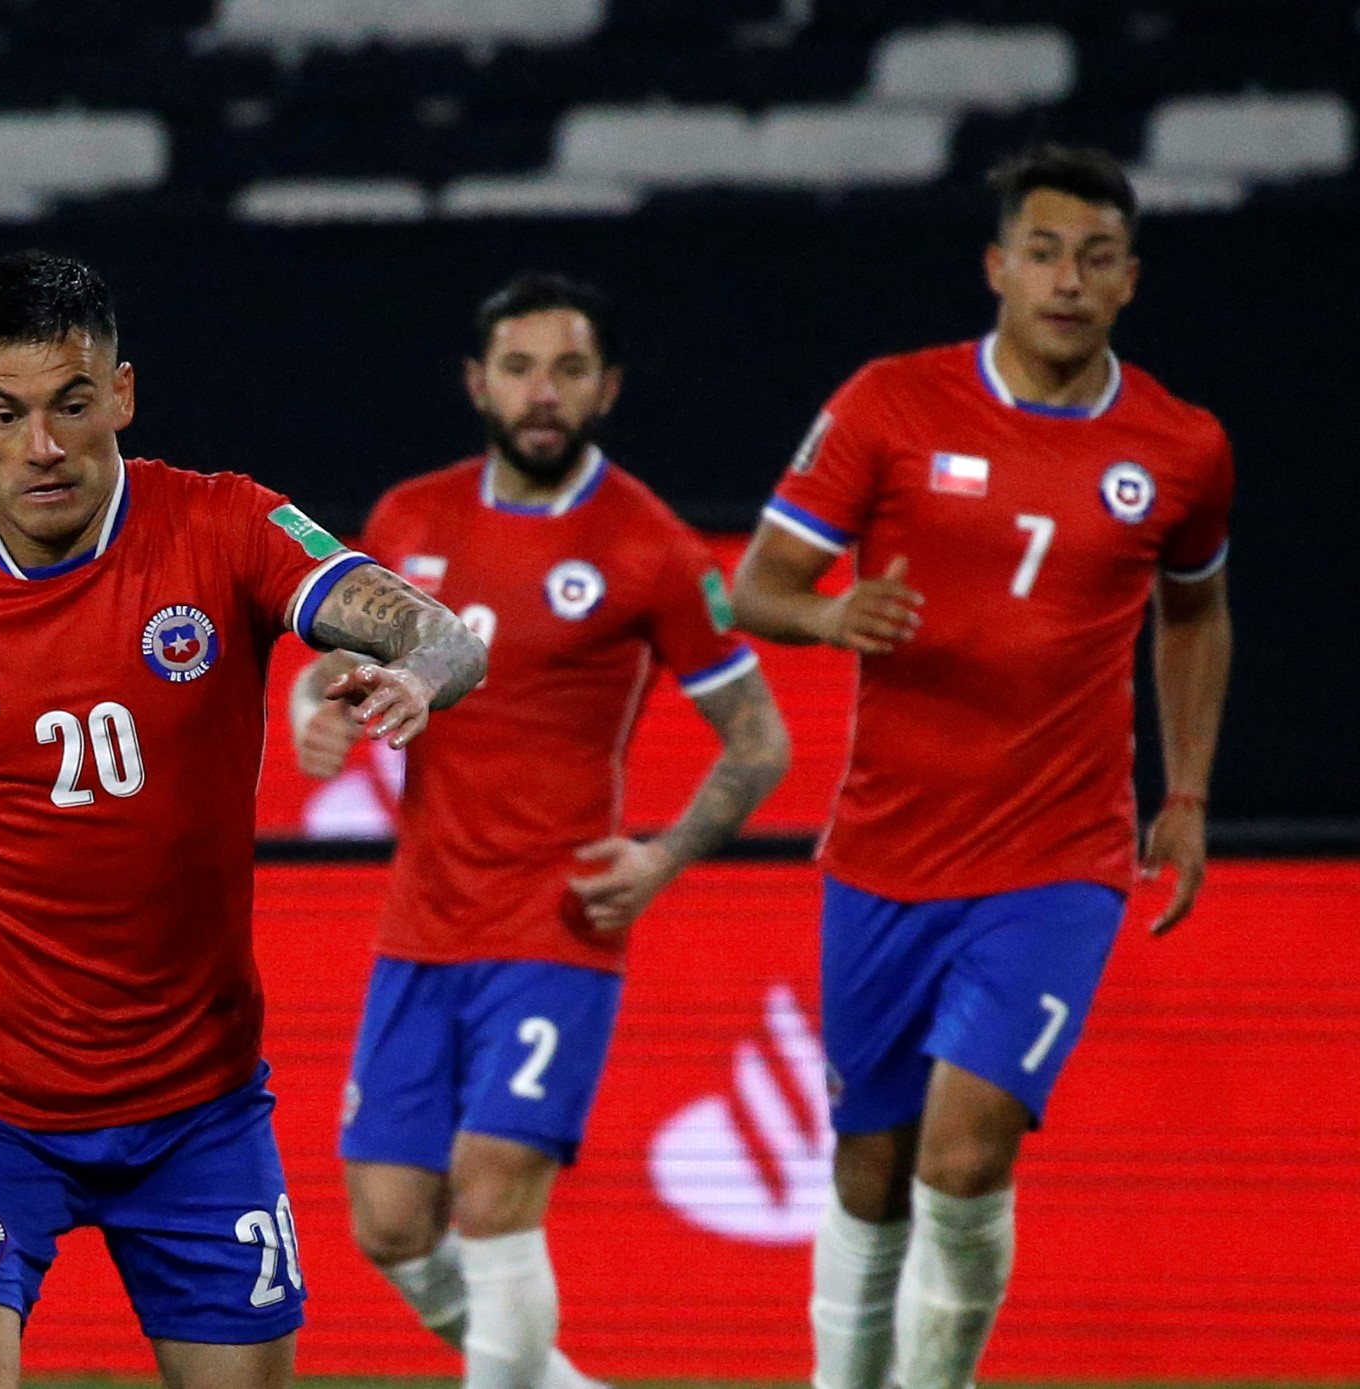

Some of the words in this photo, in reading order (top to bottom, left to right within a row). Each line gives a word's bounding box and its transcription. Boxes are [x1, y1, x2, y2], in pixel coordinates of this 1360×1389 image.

[1010, 513, 1056, 599] 7
[142, 607, 173, 655] FEDERACION
[175, 605, 188, 616] DE
[189, 608, 215, 636] FUTBOL
[170, 671, 182, 682] DE
[184, 661, 210, 682] CHILE
[35, 702, 145, 808] 20
[509, 1016, 558, 1099] 2
[1020, 993, 1069, 1073] 7
[235, 1193, 302, 1308] 20
